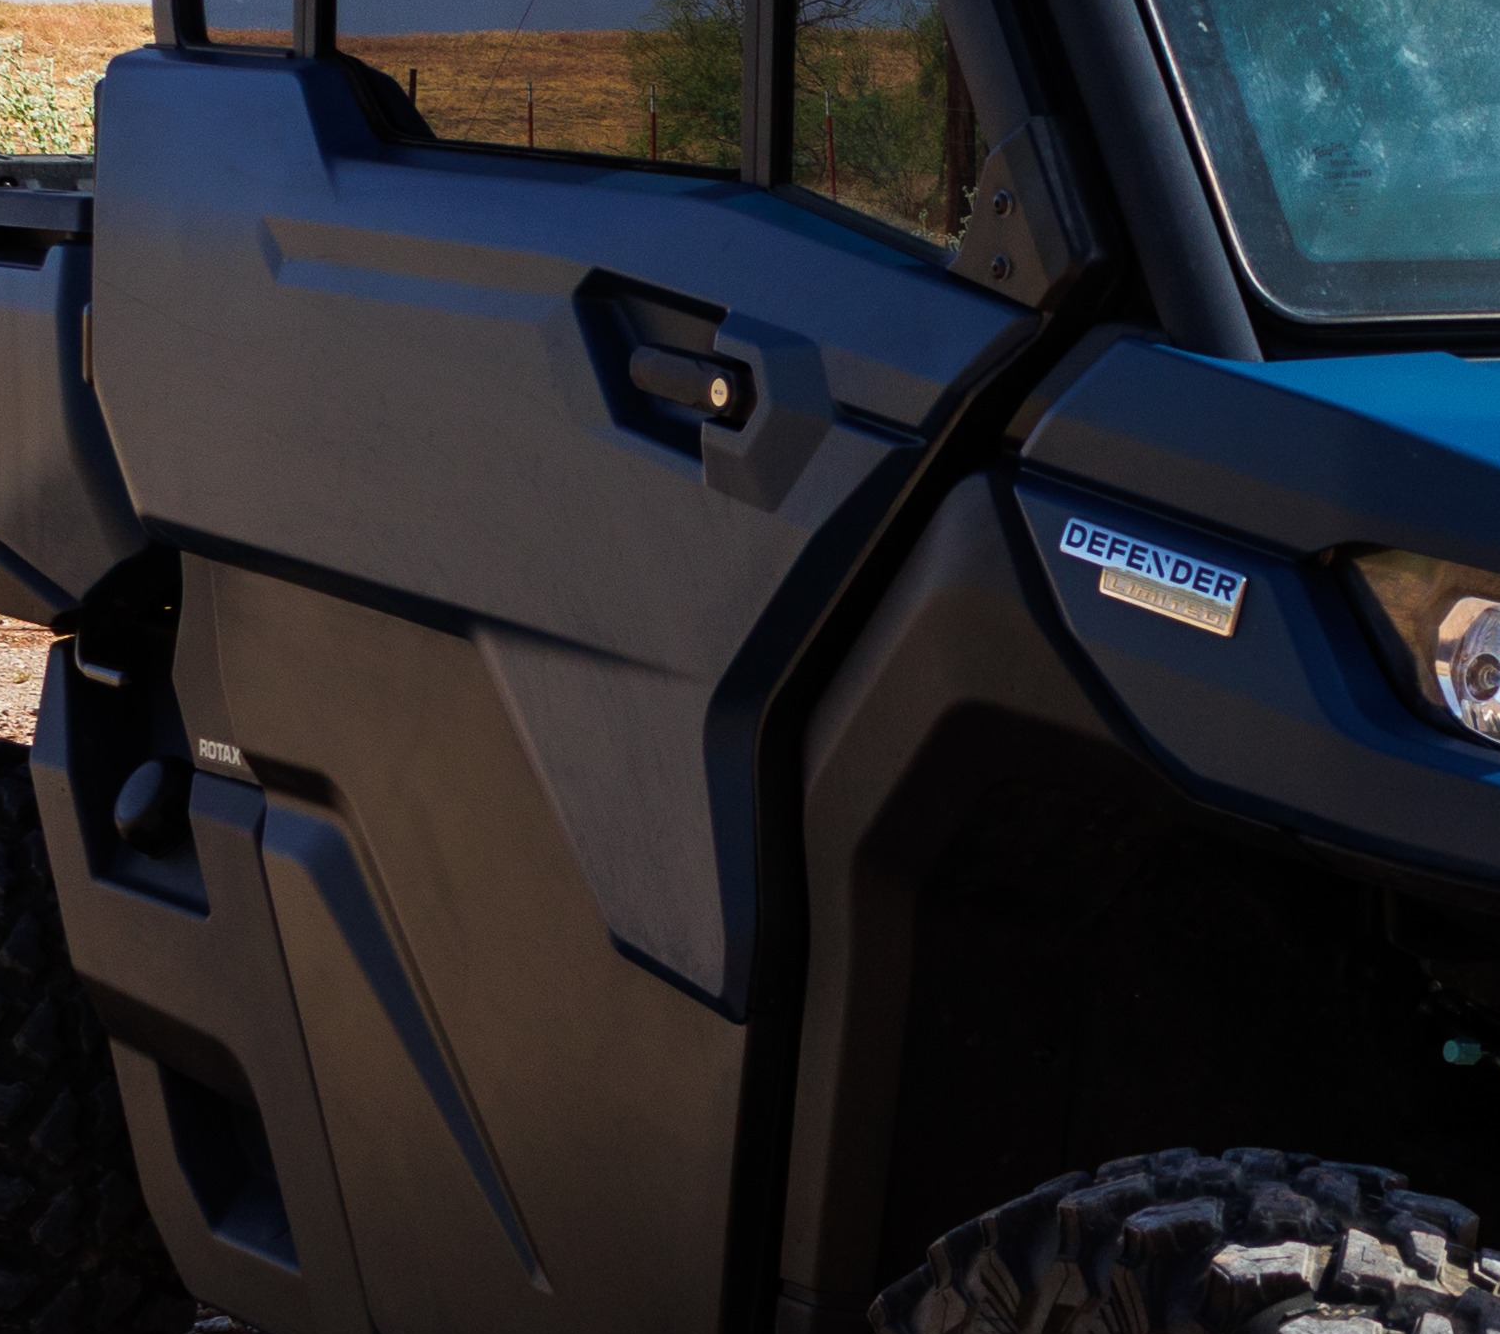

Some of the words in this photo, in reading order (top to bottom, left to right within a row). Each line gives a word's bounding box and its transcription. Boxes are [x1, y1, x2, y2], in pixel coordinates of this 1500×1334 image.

[1065, 522, 1238, 601] DEFENDER
[1109, 575, 1222, 625] LIMITED
[198, 738, 241, 766] ROTAX
